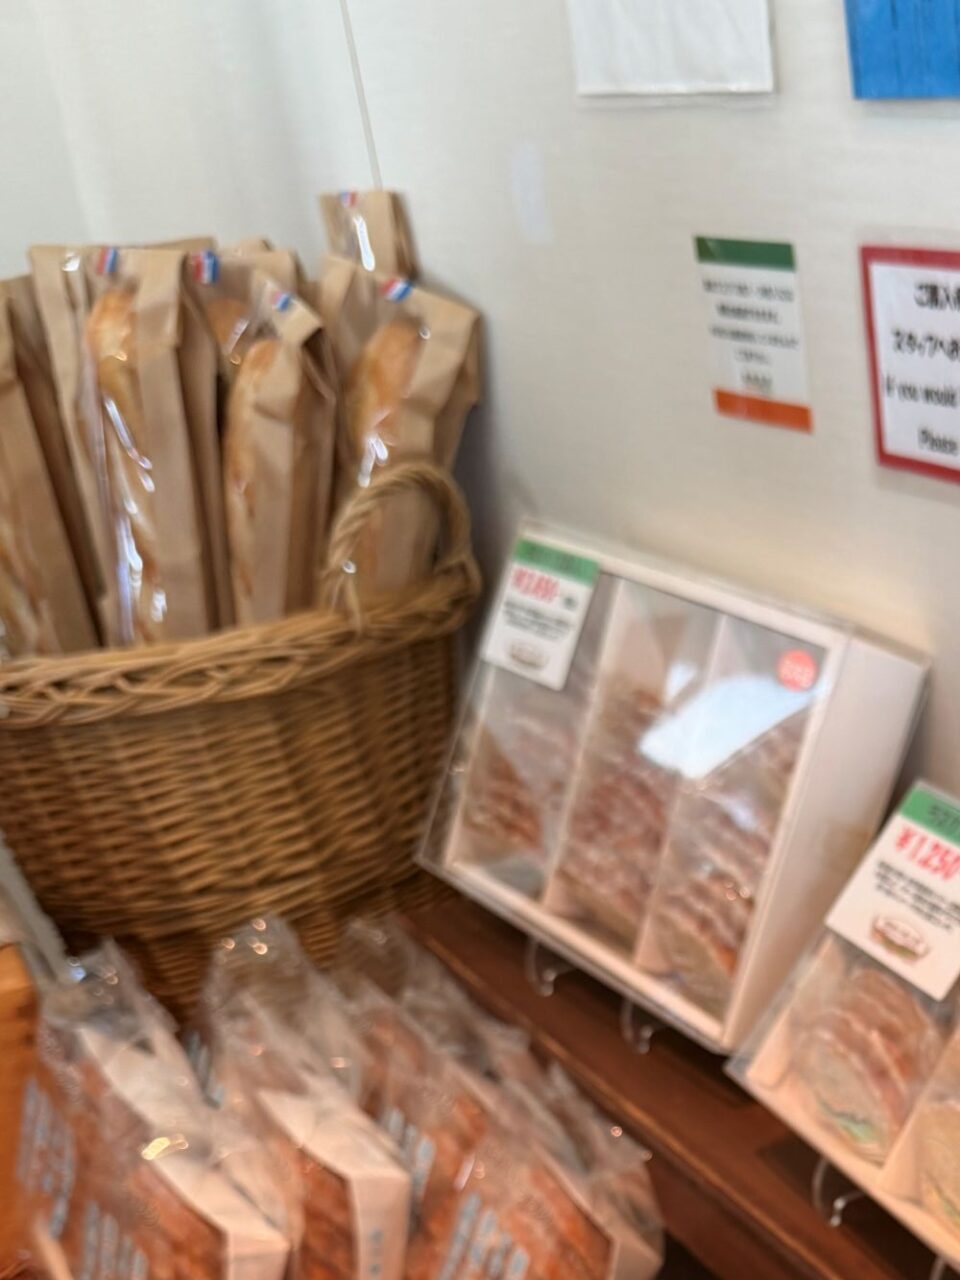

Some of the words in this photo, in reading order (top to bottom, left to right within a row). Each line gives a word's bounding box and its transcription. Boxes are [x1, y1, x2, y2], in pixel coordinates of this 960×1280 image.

[897, 384, 918, 403] you
[922, 385, 957, 408] would
[919, 427, 959, 456] Please
